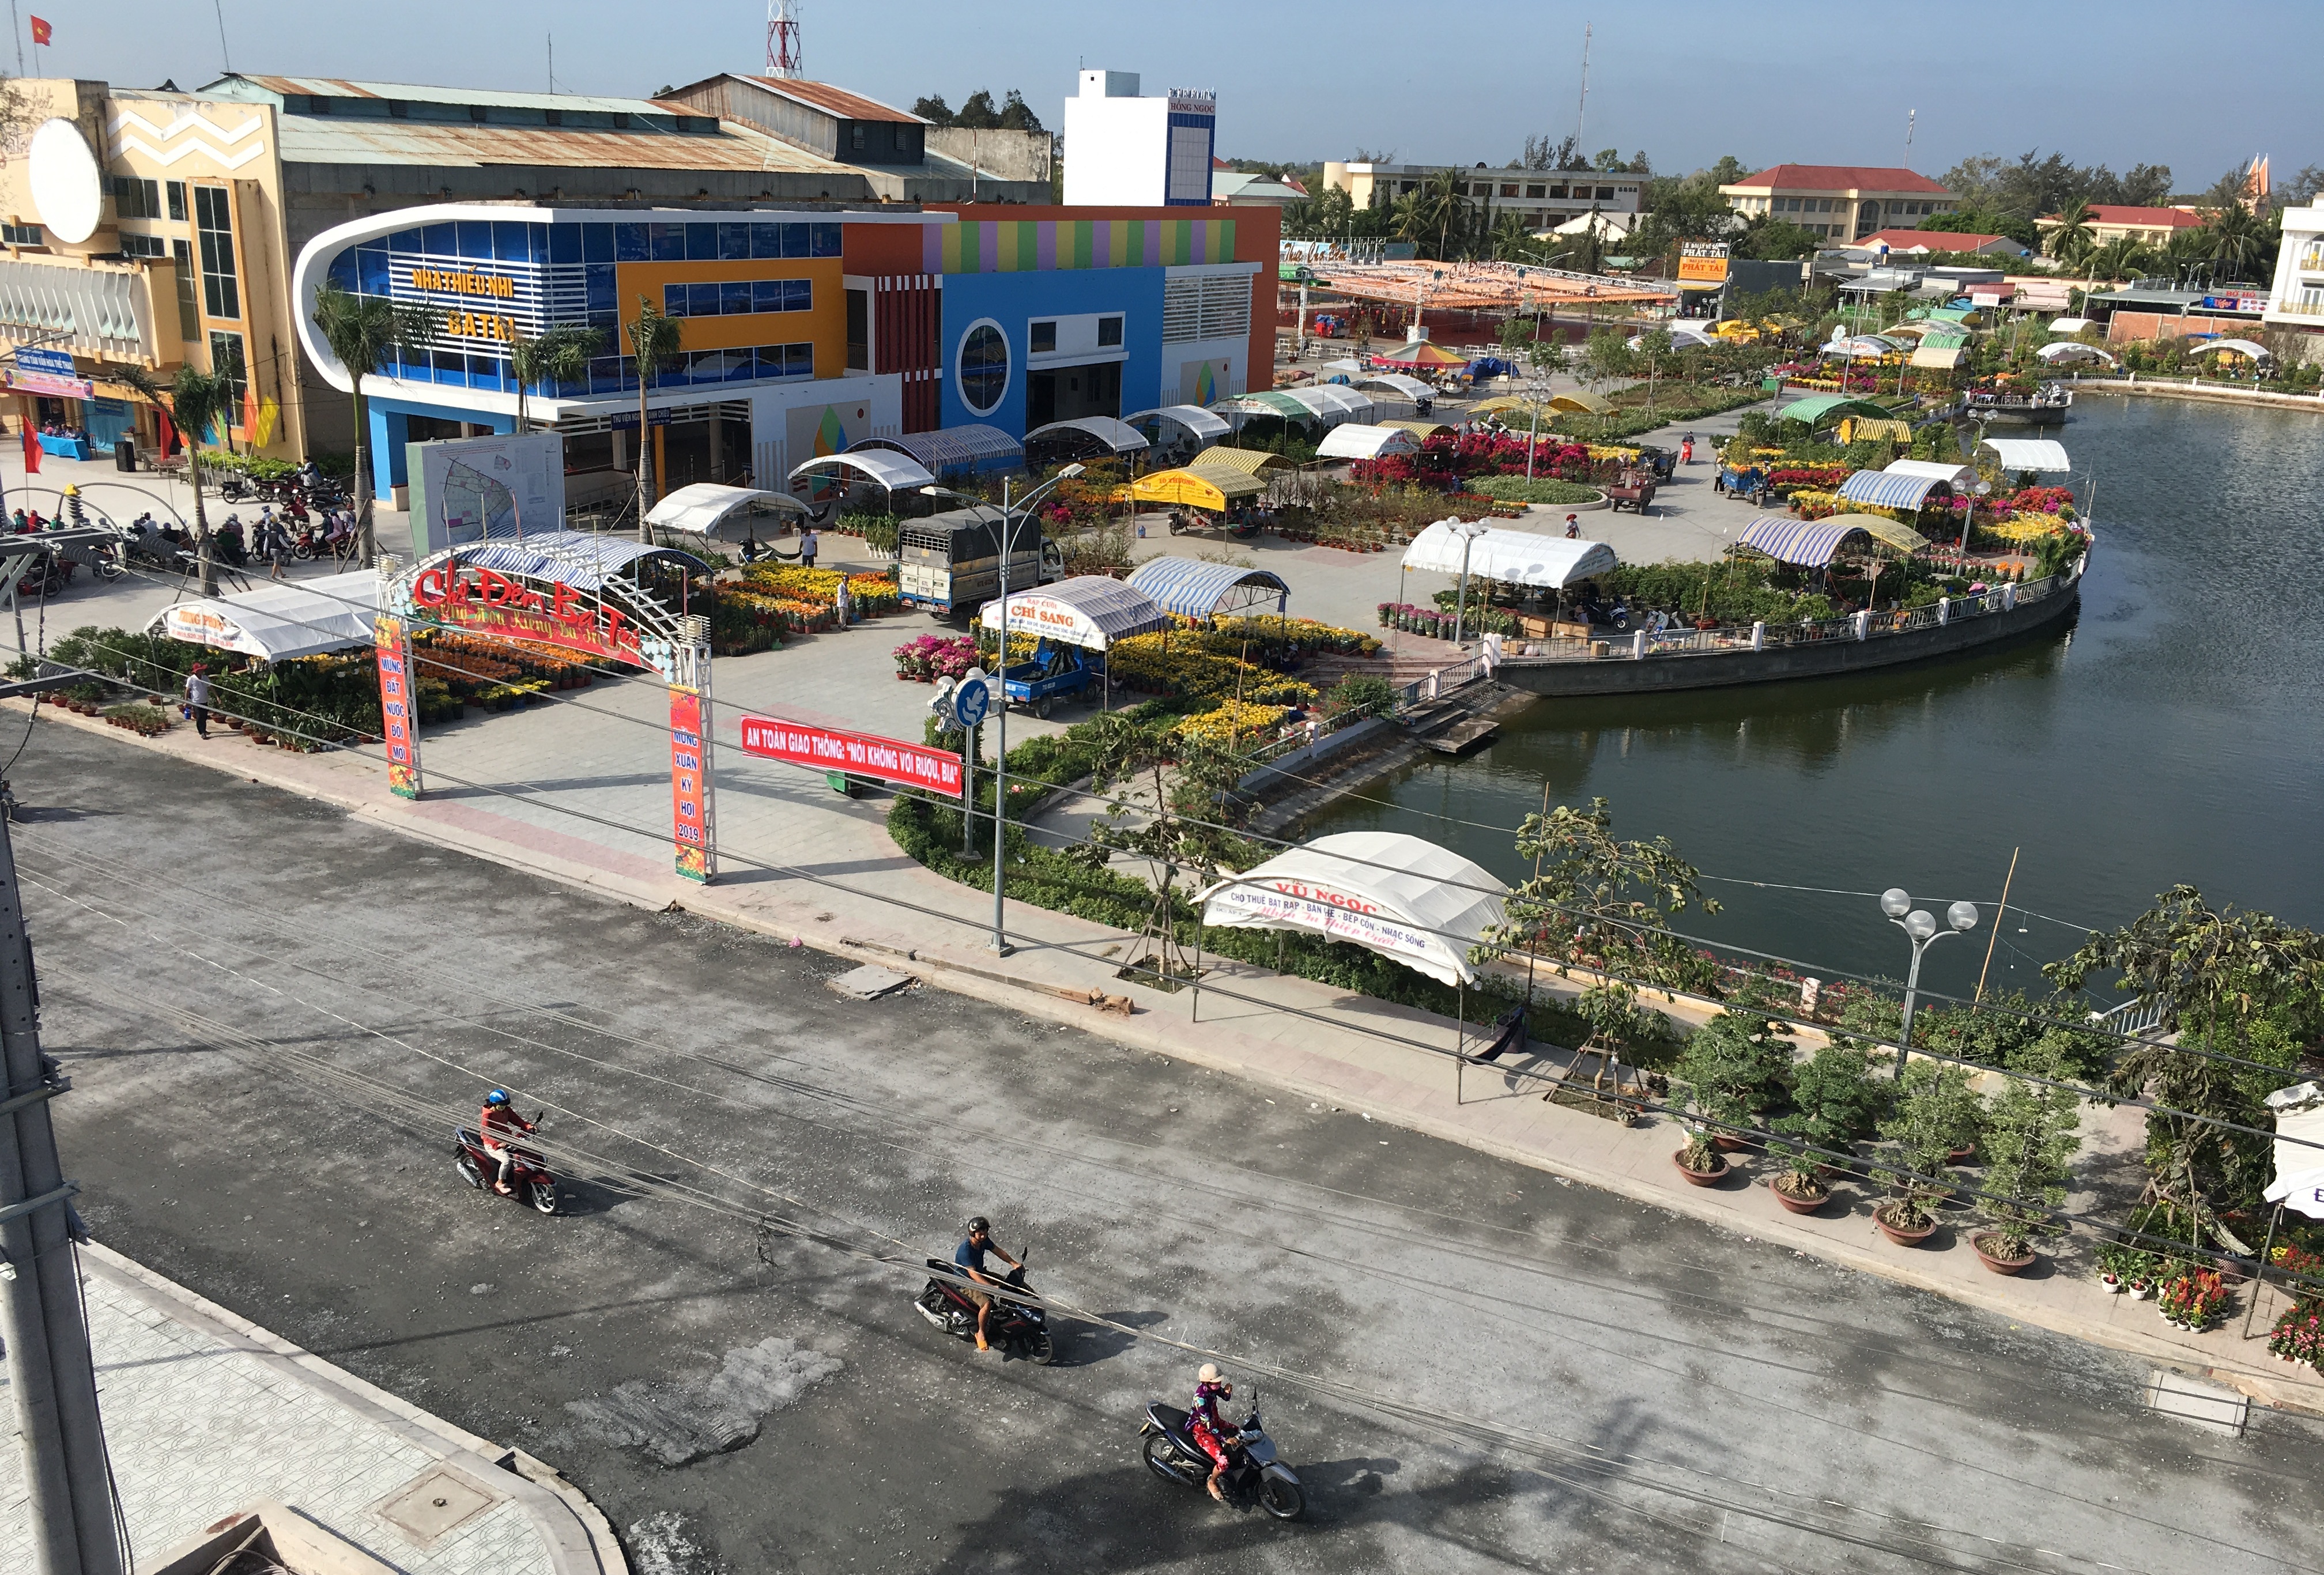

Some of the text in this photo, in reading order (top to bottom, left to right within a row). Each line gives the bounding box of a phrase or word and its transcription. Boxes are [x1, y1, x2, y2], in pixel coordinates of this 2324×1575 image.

[1194, 104, 1214, 114] NGỌC
[1683, 248, 1725, 258] PHÁT TÀI
[1682, 263, 1723, 272] PHÁT TÀI
[412, 264, 443, 290] NHÀ
[488, 275, 514, 298] NHI
[550, 580, 597, 631] Ba
[1011, 605, 1074, 628] CHÍ SANG
[381, 655, 402, 674] MỪNG
[386, 677, 400, 695] ĐẤT
[386, 701, 405, 717] NƯỚC
[747, 727, 760, 747] AN
[761, 725, 787, 751] TOÀN
[788, 732, 810, 754] GIAO
[812, 733, 845, 760] THÔNG:
[867, 744, 897, 770] KHÔNG
[676, 751, 697, 771] XUÂN
[681, 775, 693, 793] KỶ
[681, 800, 695, 819] HỢI
[678, 824, 699, 841] 2019
[1231, 892, 1245, 902] CHO
[1247, 894, 1266, 905] THUÊ
